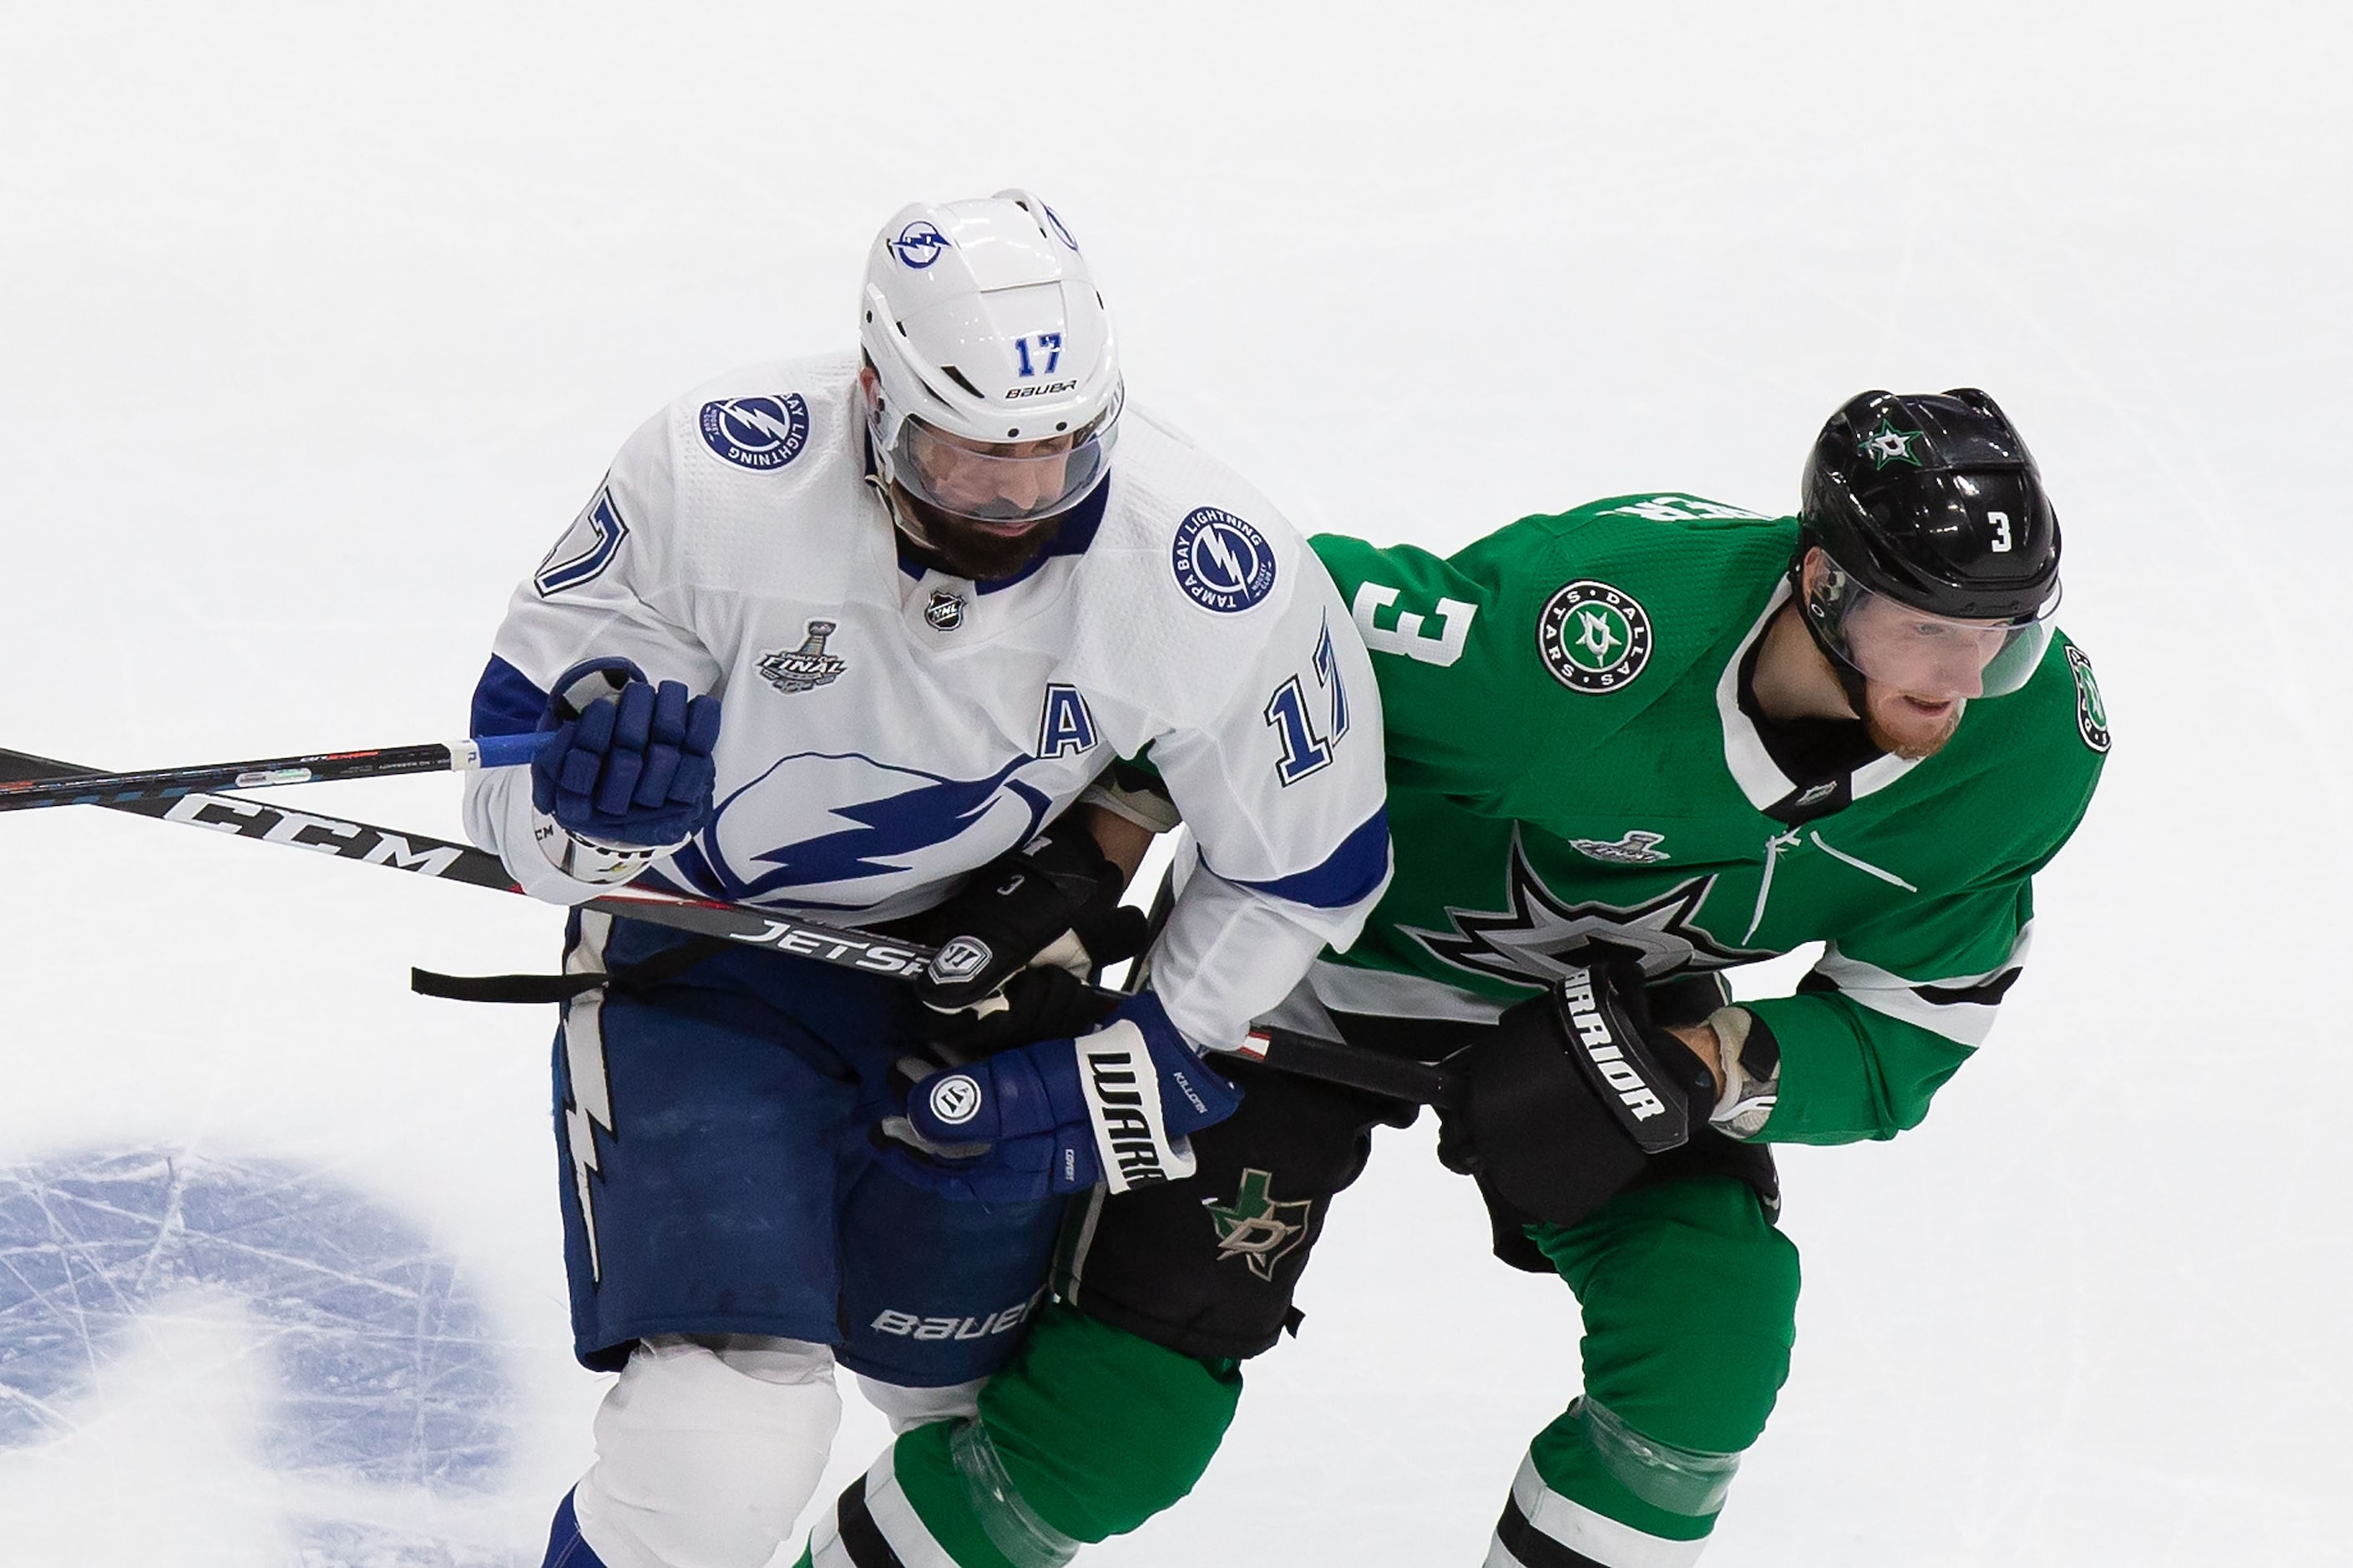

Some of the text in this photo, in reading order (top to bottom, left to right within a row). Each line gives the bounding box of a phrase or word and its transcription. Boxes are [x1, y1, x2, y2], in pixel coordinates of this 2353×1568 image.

[1015, 332, 1062, 377] 17
[728, 422, 805, 465] LIGHTNING
[534, 469, 630, 598] 7
[1176, 509, 1263, 608] TAMPA BAY LIGHTNING
[1987, 511, 2012, 553] 3
[762, 656, 842, 674] FINAL
[1353, 579, 1479, 668] 3
[1546, 590, 1581, 678] STARS
[1601, 591, 1645, 686] DALLAS
[1035, 682, 1099, 759] A
[1263, 604, 1349, 787] 17
[163, 792, 464, 878] CCM
